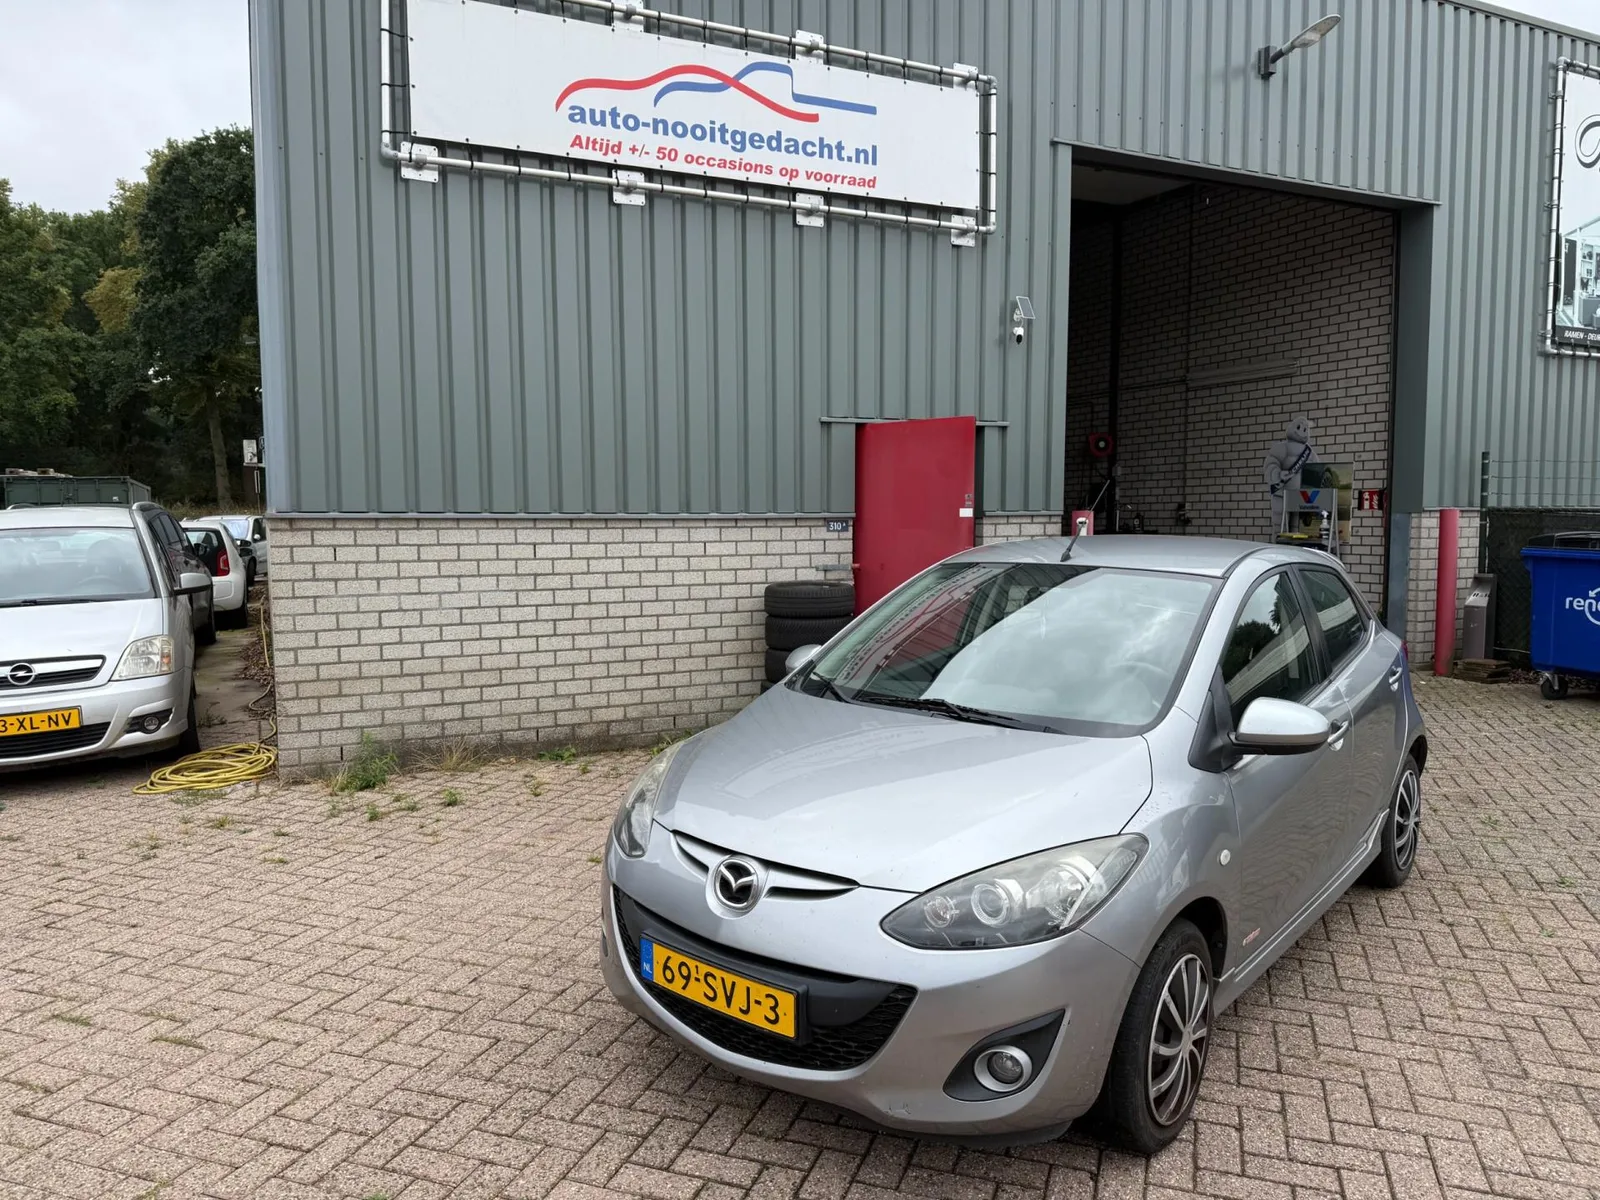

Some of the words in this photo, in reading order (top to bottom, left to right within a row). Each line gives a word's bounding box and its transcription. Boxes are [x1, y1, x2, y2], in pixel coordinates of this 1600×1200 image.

[568, 104, 878, 166] auto-nooitgedacht.nl
[570, 134, 623, 155] Altijd
[629, 144, 650, 158] +/-
[656, 146, 679, 161] 50
[684, 154, 774, 175] occasions
[779, 167, 799, 180] op
[805, 169, 877, 189] voorraad
[1564, 330, 1584, 339] RAMEN
[0, 712, 73, 733] 3-XL-NV
[643, 961, 653, 975] NL
[662, 955, 780, 1026] 69-SVJ-3
